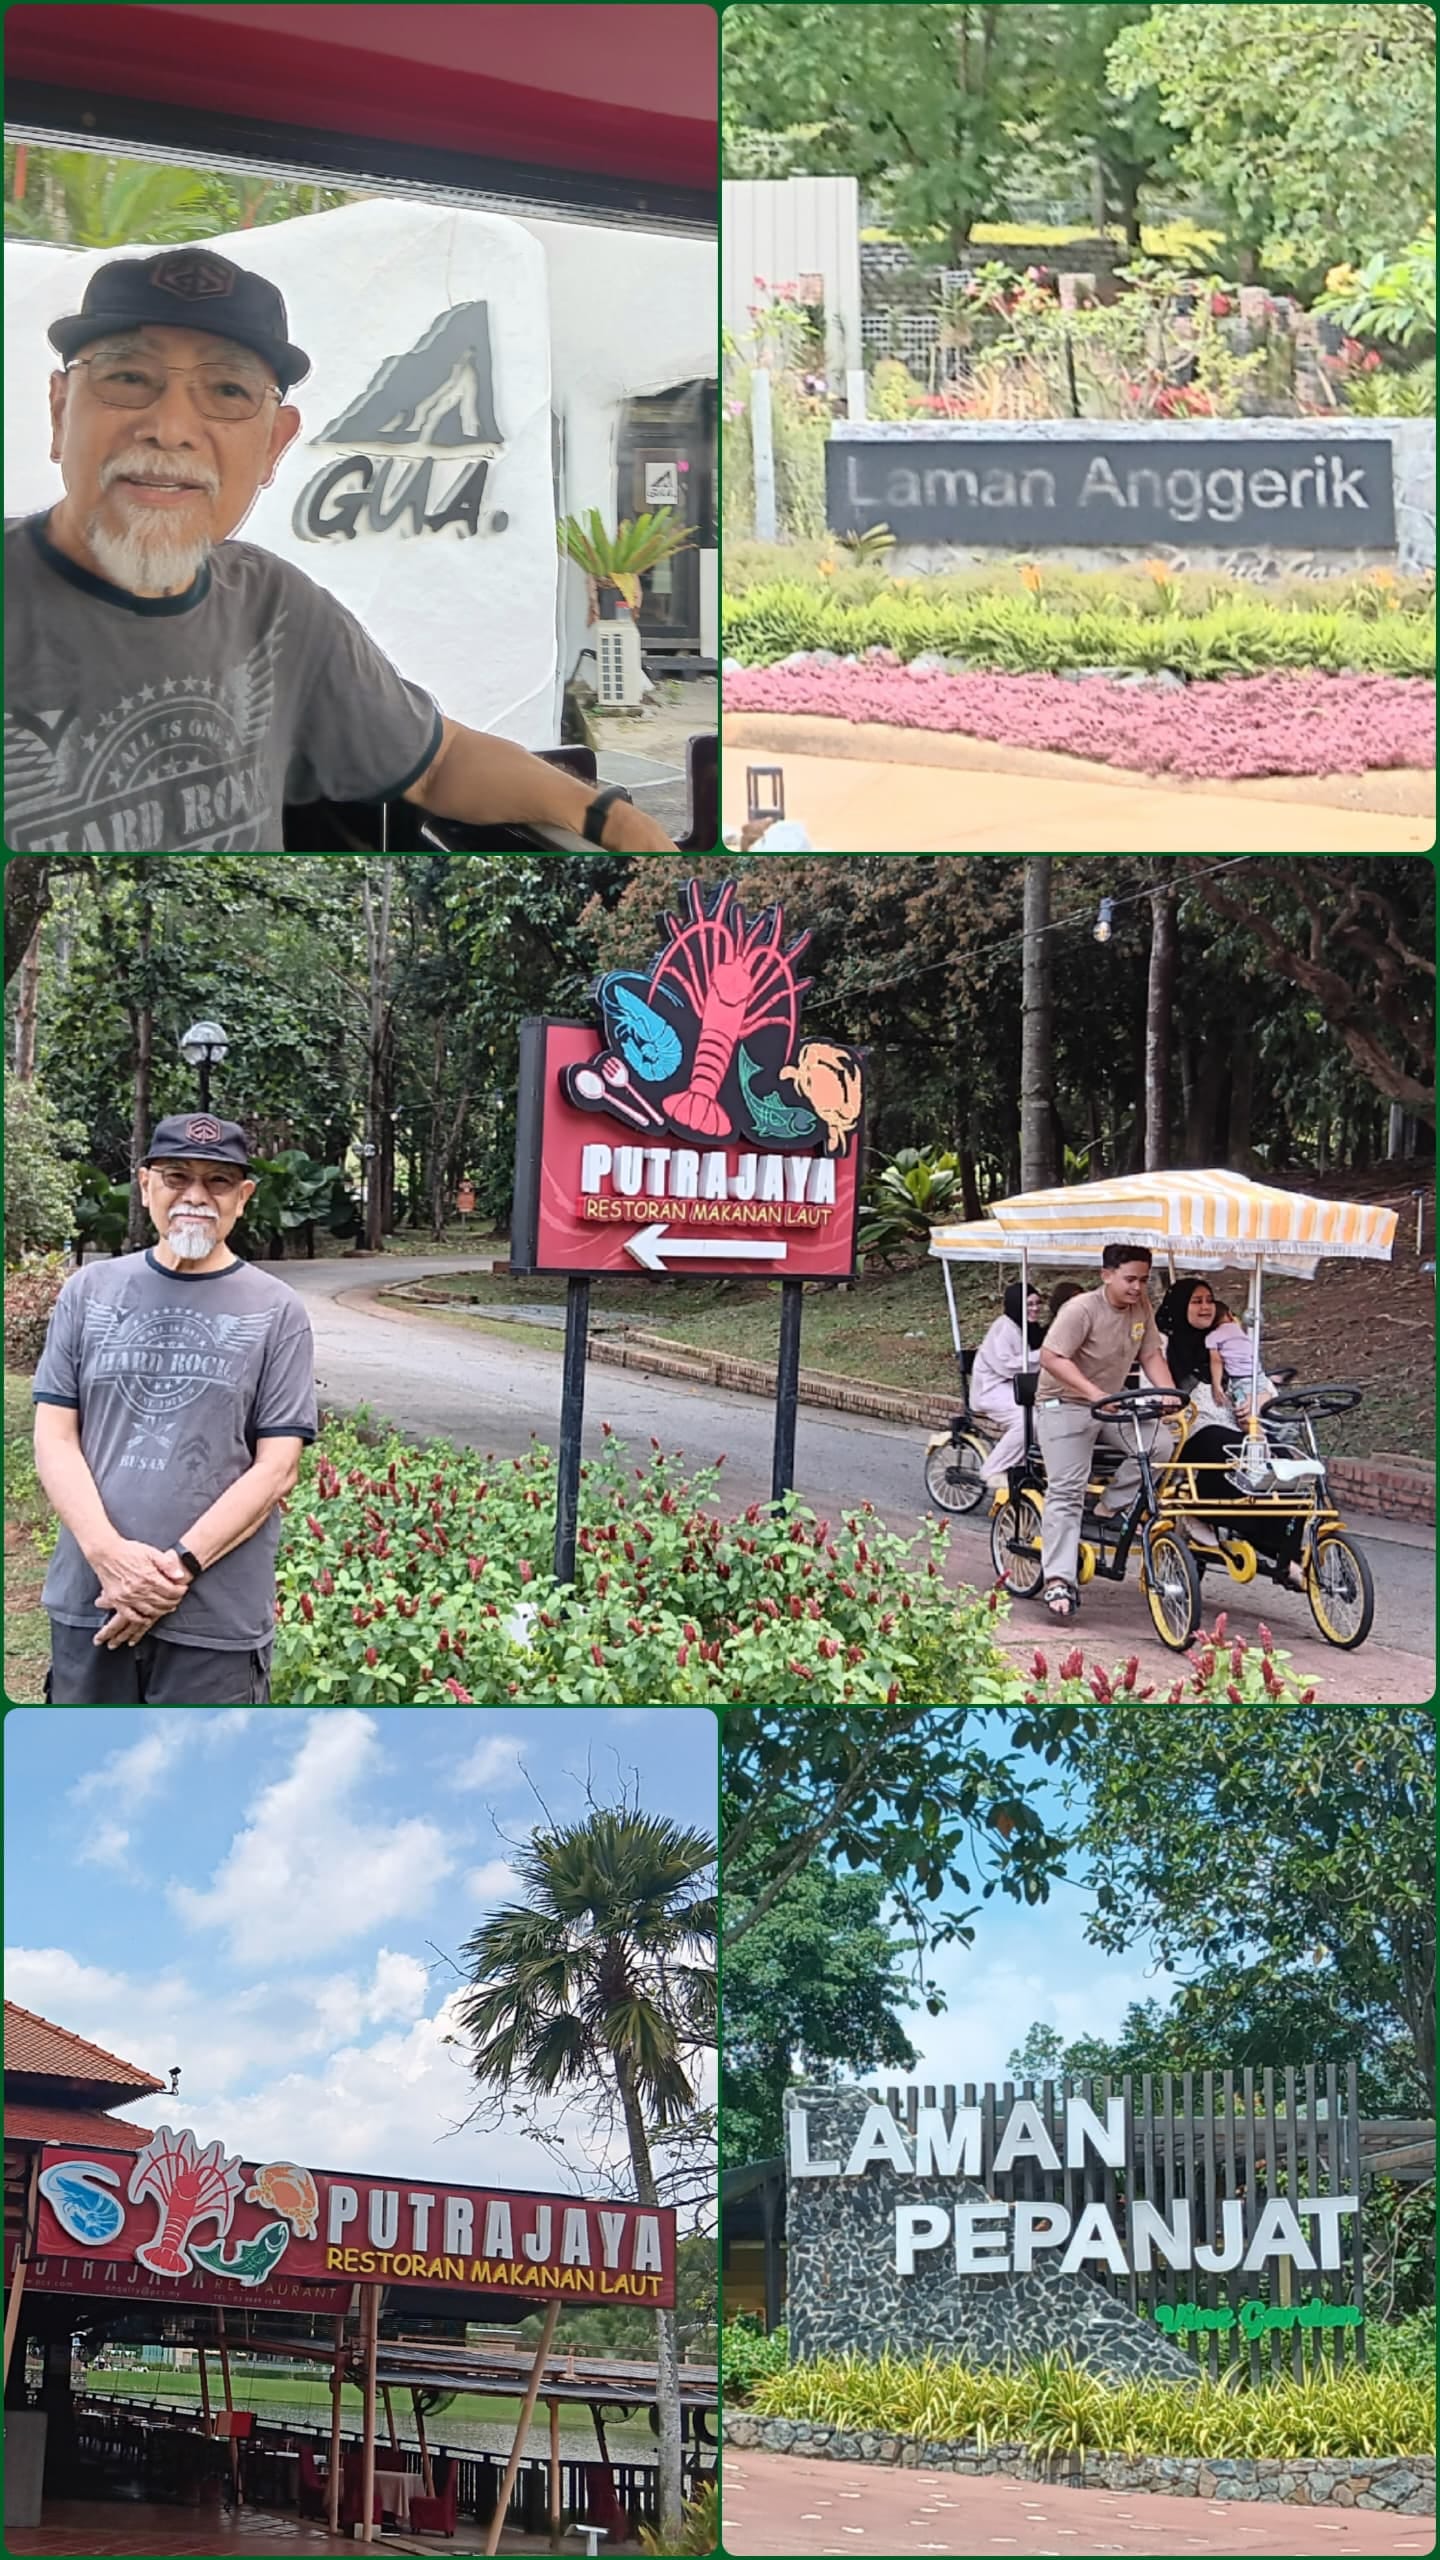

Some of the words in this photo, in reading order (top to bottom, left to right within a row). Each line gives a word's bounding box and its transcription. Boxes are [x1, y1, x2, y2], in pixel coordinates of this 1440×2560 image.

[846, 456, 1056, 508] Laman
[1077, 455, 1369, 523] Anggerik
[160, 719, 183, 741] IS
[581, 1144, 836, 1204] PUTRAJAYA
[586, 1199, 686, 1220] RESTORAN
[691, 1202, 782, 1224] MAKANAN
[787, 1206, 832, 1225] LAUT
[100, 1351, 164, 1373] HARD
[170, 1353, 233, 1378] ROCK
[119, 1455, 168, 1471] BUSAN
[789, 2097, 1126, 2177] LAMAN
[326, 2185, 663, 2273] PUTRAJAYA
[897, 2196, 1360, 2275] PEPANJAT
[326, 2248, 465, 2281] RESTORAN
[471, 2260, 595, 2293] MAKANAN
[600, 2271, 664, 2297] LAUT
[1154, 2303, 1237, 2333] Vine
[1239, 2298, 1364, 2339] Garden
